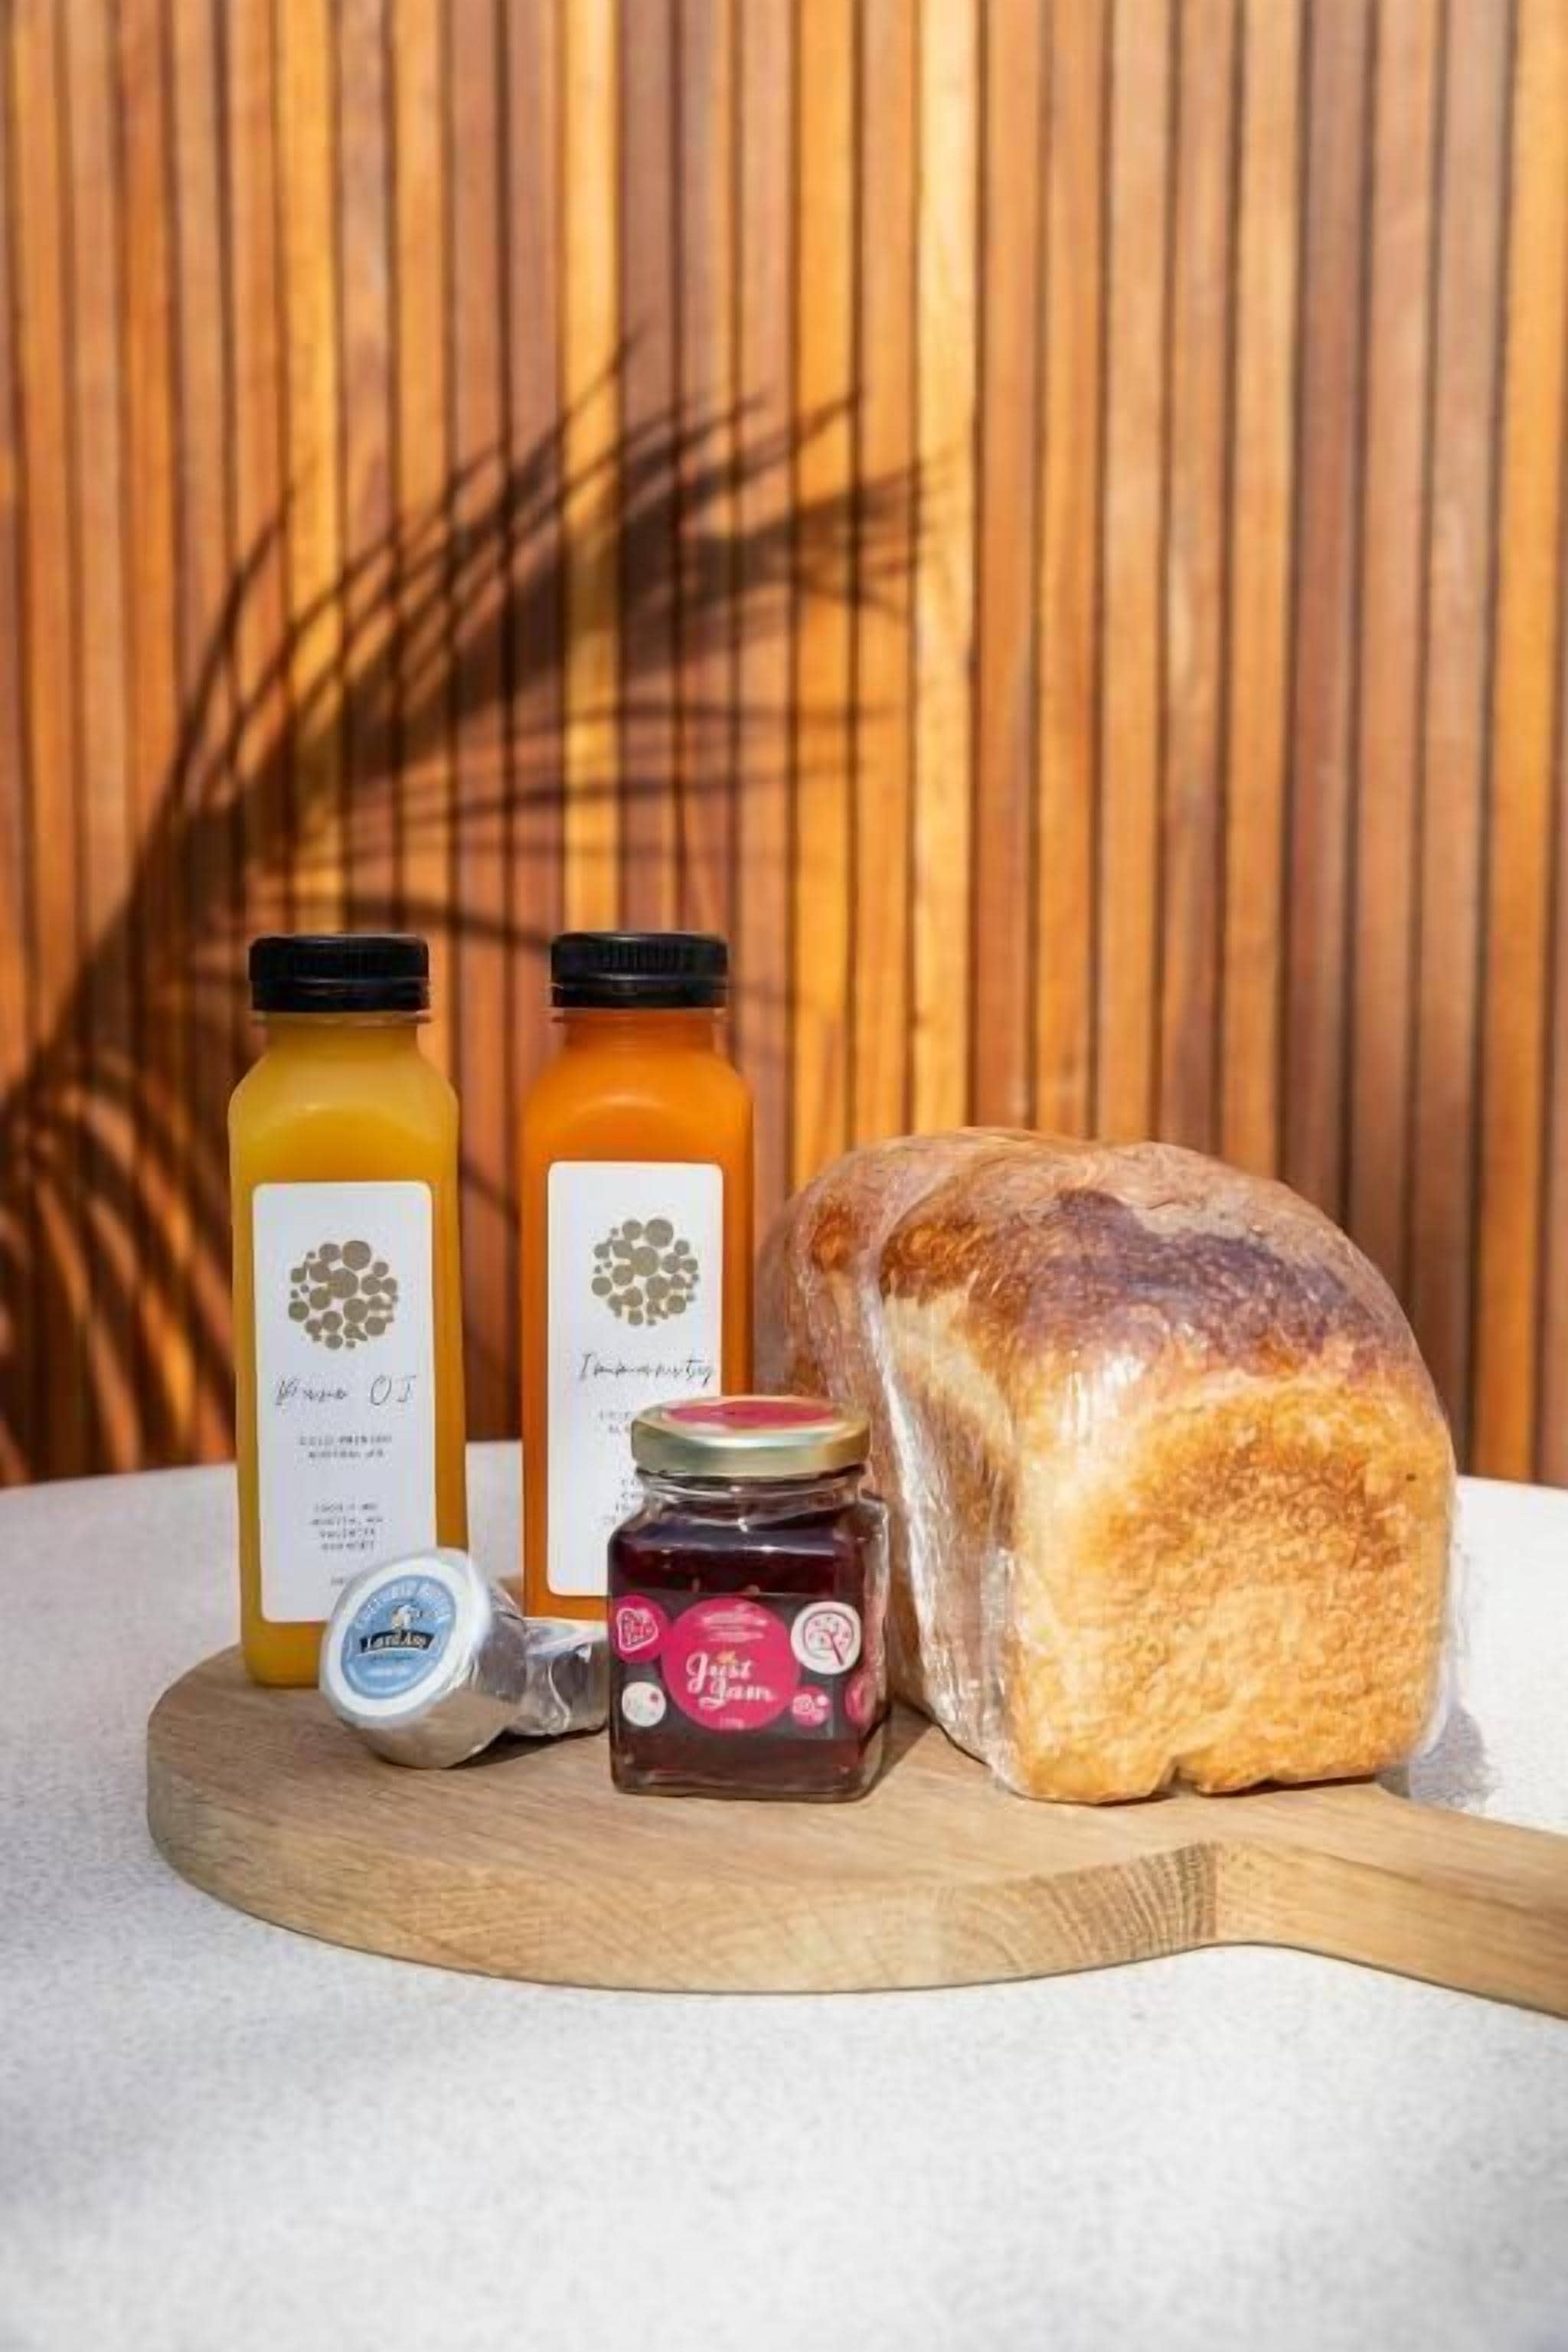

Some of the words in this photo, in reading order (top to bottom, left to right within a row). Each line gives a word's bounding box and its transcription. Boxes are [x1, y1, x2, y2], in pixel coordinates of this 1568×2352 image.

[370, 1375, 417, 1406] OJ
[686, 1651, 752, 1694] Just
[698, 1677, 778, 1710] Jam
